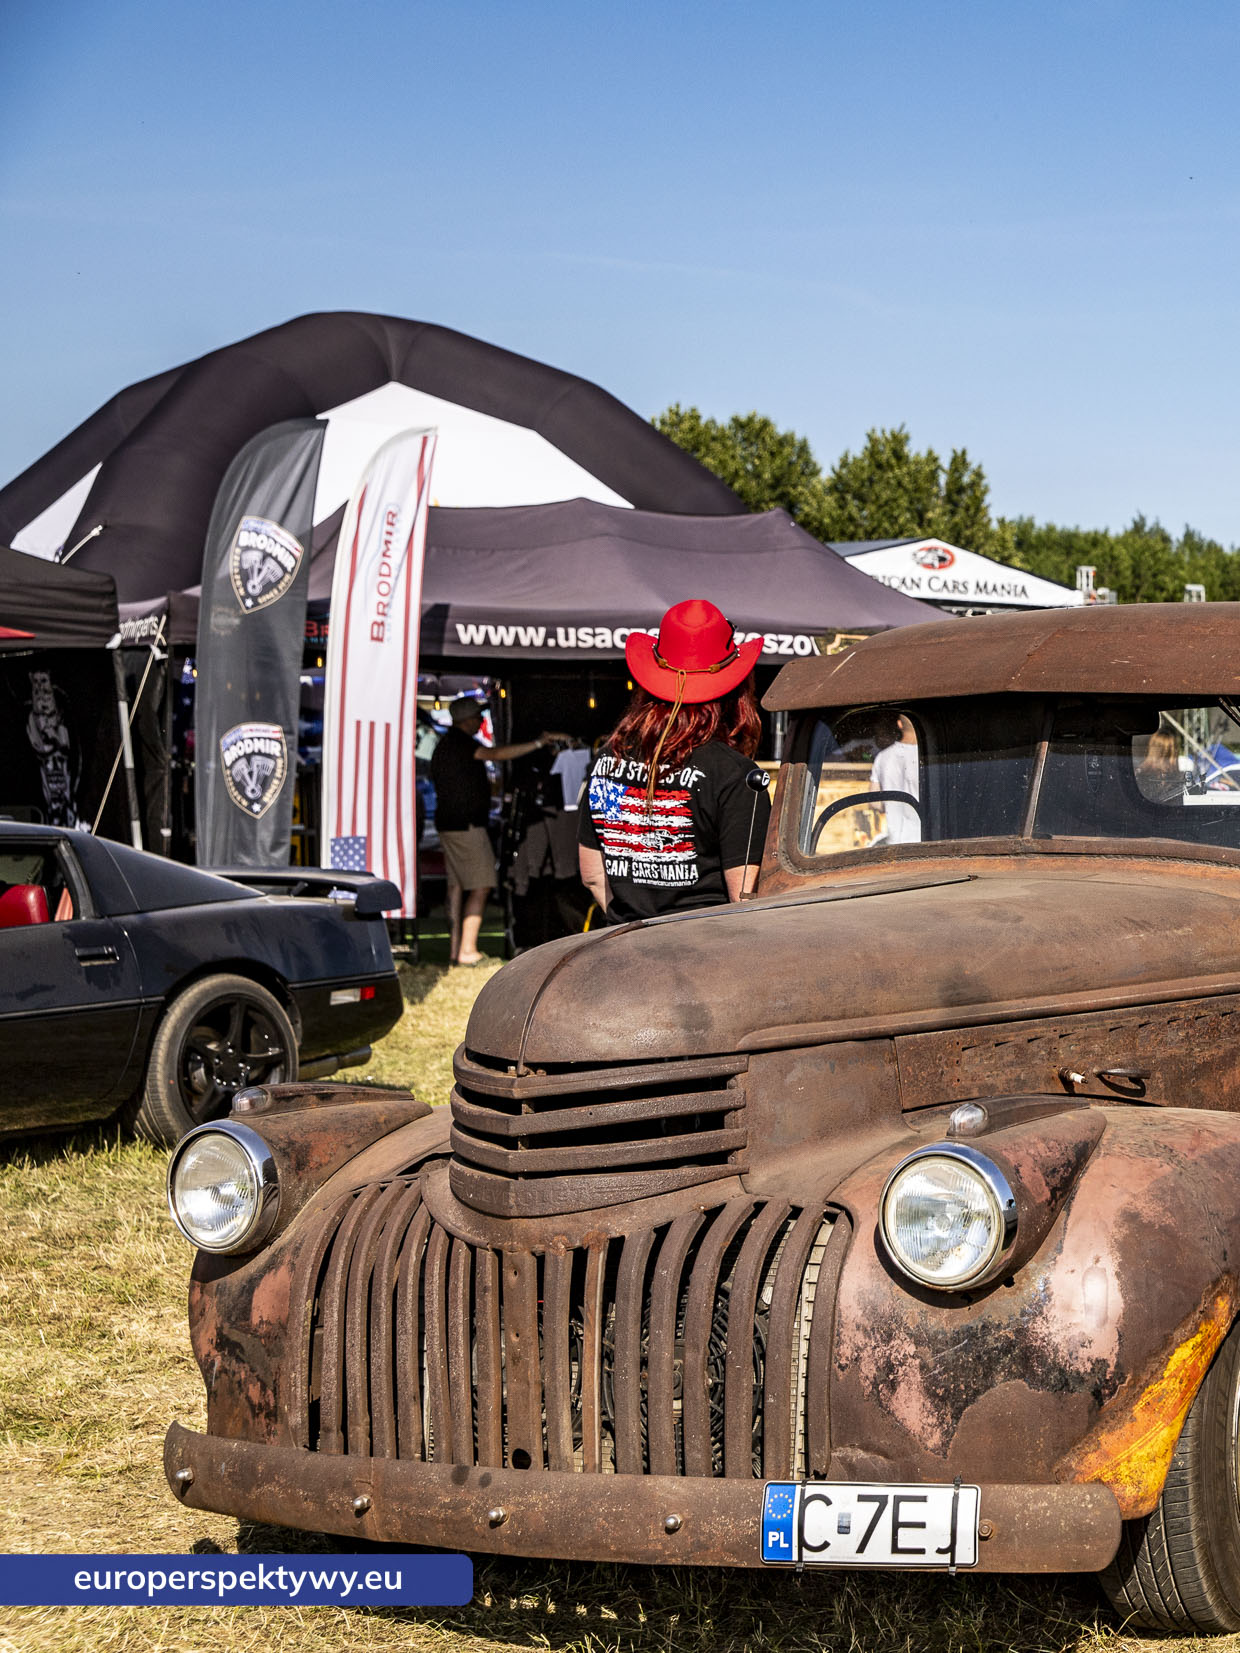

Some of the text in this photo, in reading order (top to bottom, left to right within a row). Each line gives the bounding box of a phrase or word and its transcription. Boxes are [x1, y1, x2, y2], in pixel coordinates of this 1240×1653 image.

[239, 530, 296, 573] BRODMIR
[370, 510, 398, 643] BRODMIR
[928, 576, 969, 596] CARS
[974, 580, 1028, 598] MANIA
[224, 738, 281, 767] BRODMIR
[632, 861, 659, 880] CARS
[659, 863, 699, 880] MANIA
[767, 1531, 790, 1548] PL
